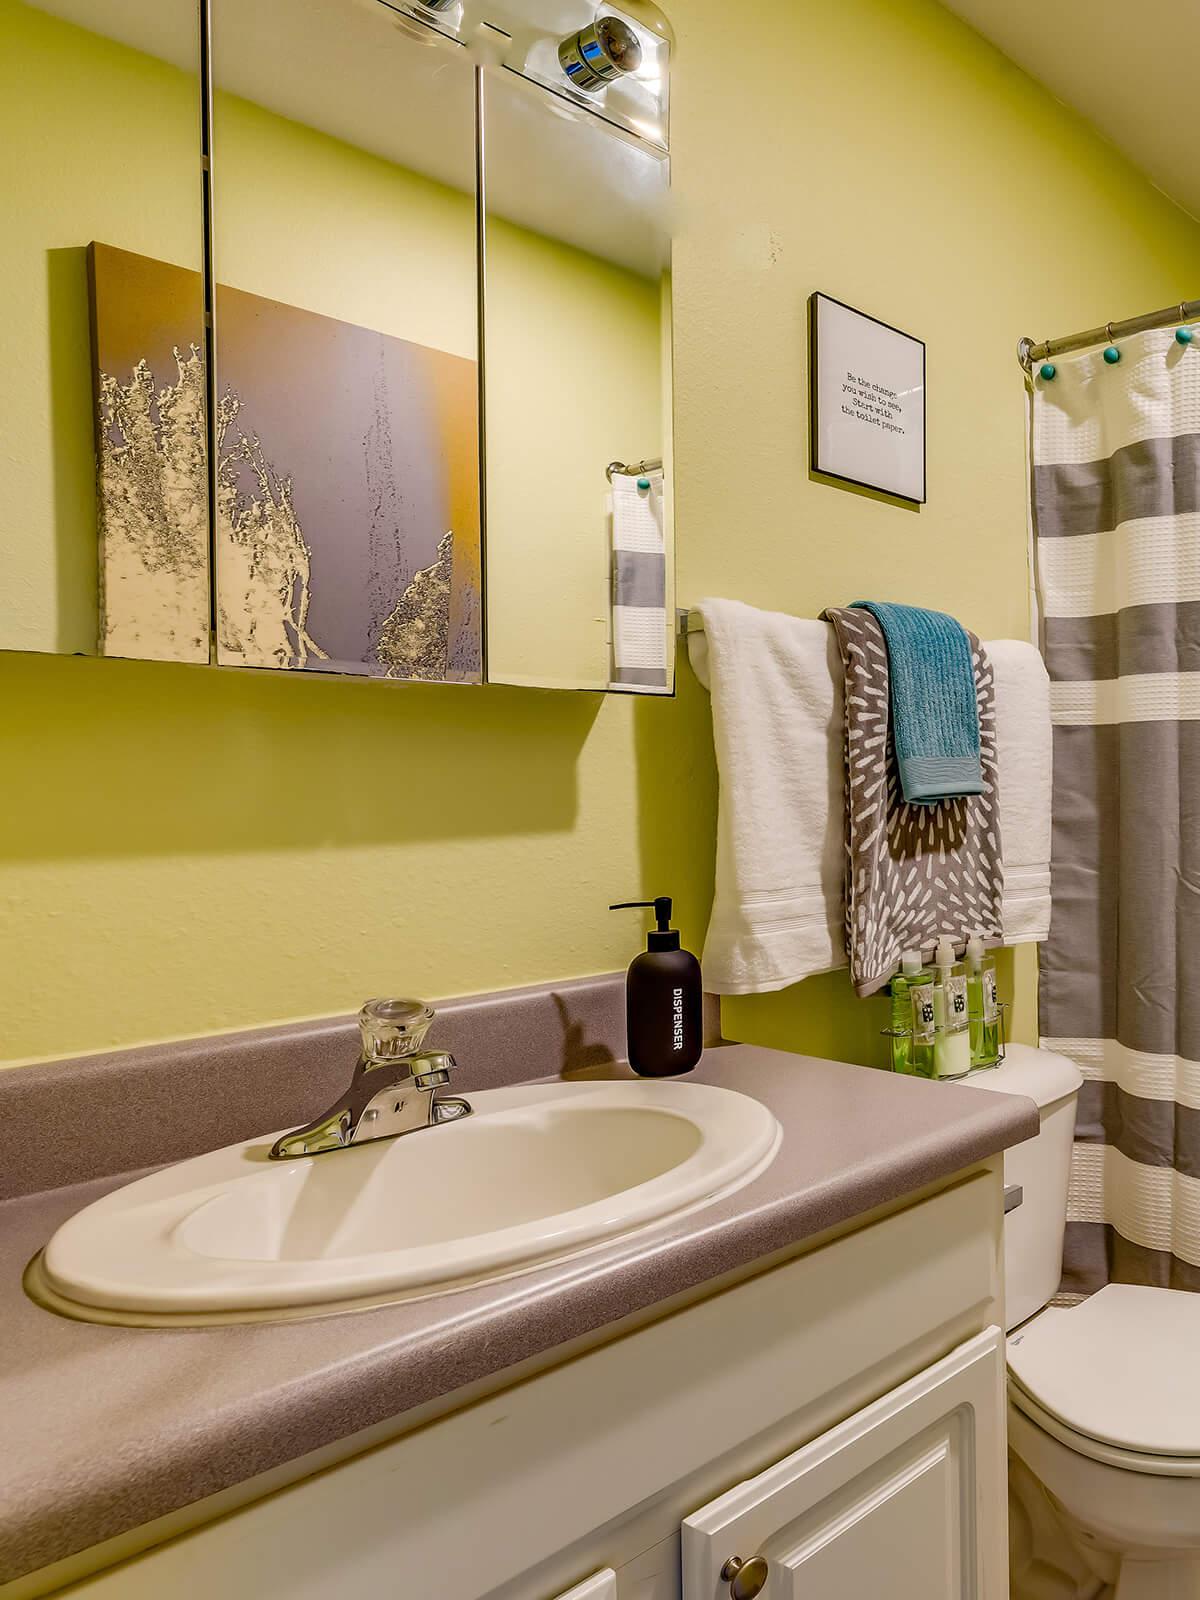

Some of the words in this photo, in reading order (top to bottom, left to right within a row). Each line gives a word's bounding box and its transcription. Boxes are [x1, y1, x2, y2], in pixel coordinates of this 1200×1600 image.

[847, 372, 857, 383] Be
[858, 377, 871, 389] the
[842, 383, 857, 395] you
[858, 390, 877, 402] wish
[878, 396, 887, 406] to
[887, 401, 902, 413] see,
[852, 397, 874, 412] Start
[874, 407, 893, 420] with
[841, 404, 855, 417] the
[856, 410, 881, 426] toilet
[881, 421, 905, 434] paper.
[672, 987, 683, 1051] DISPENSER
